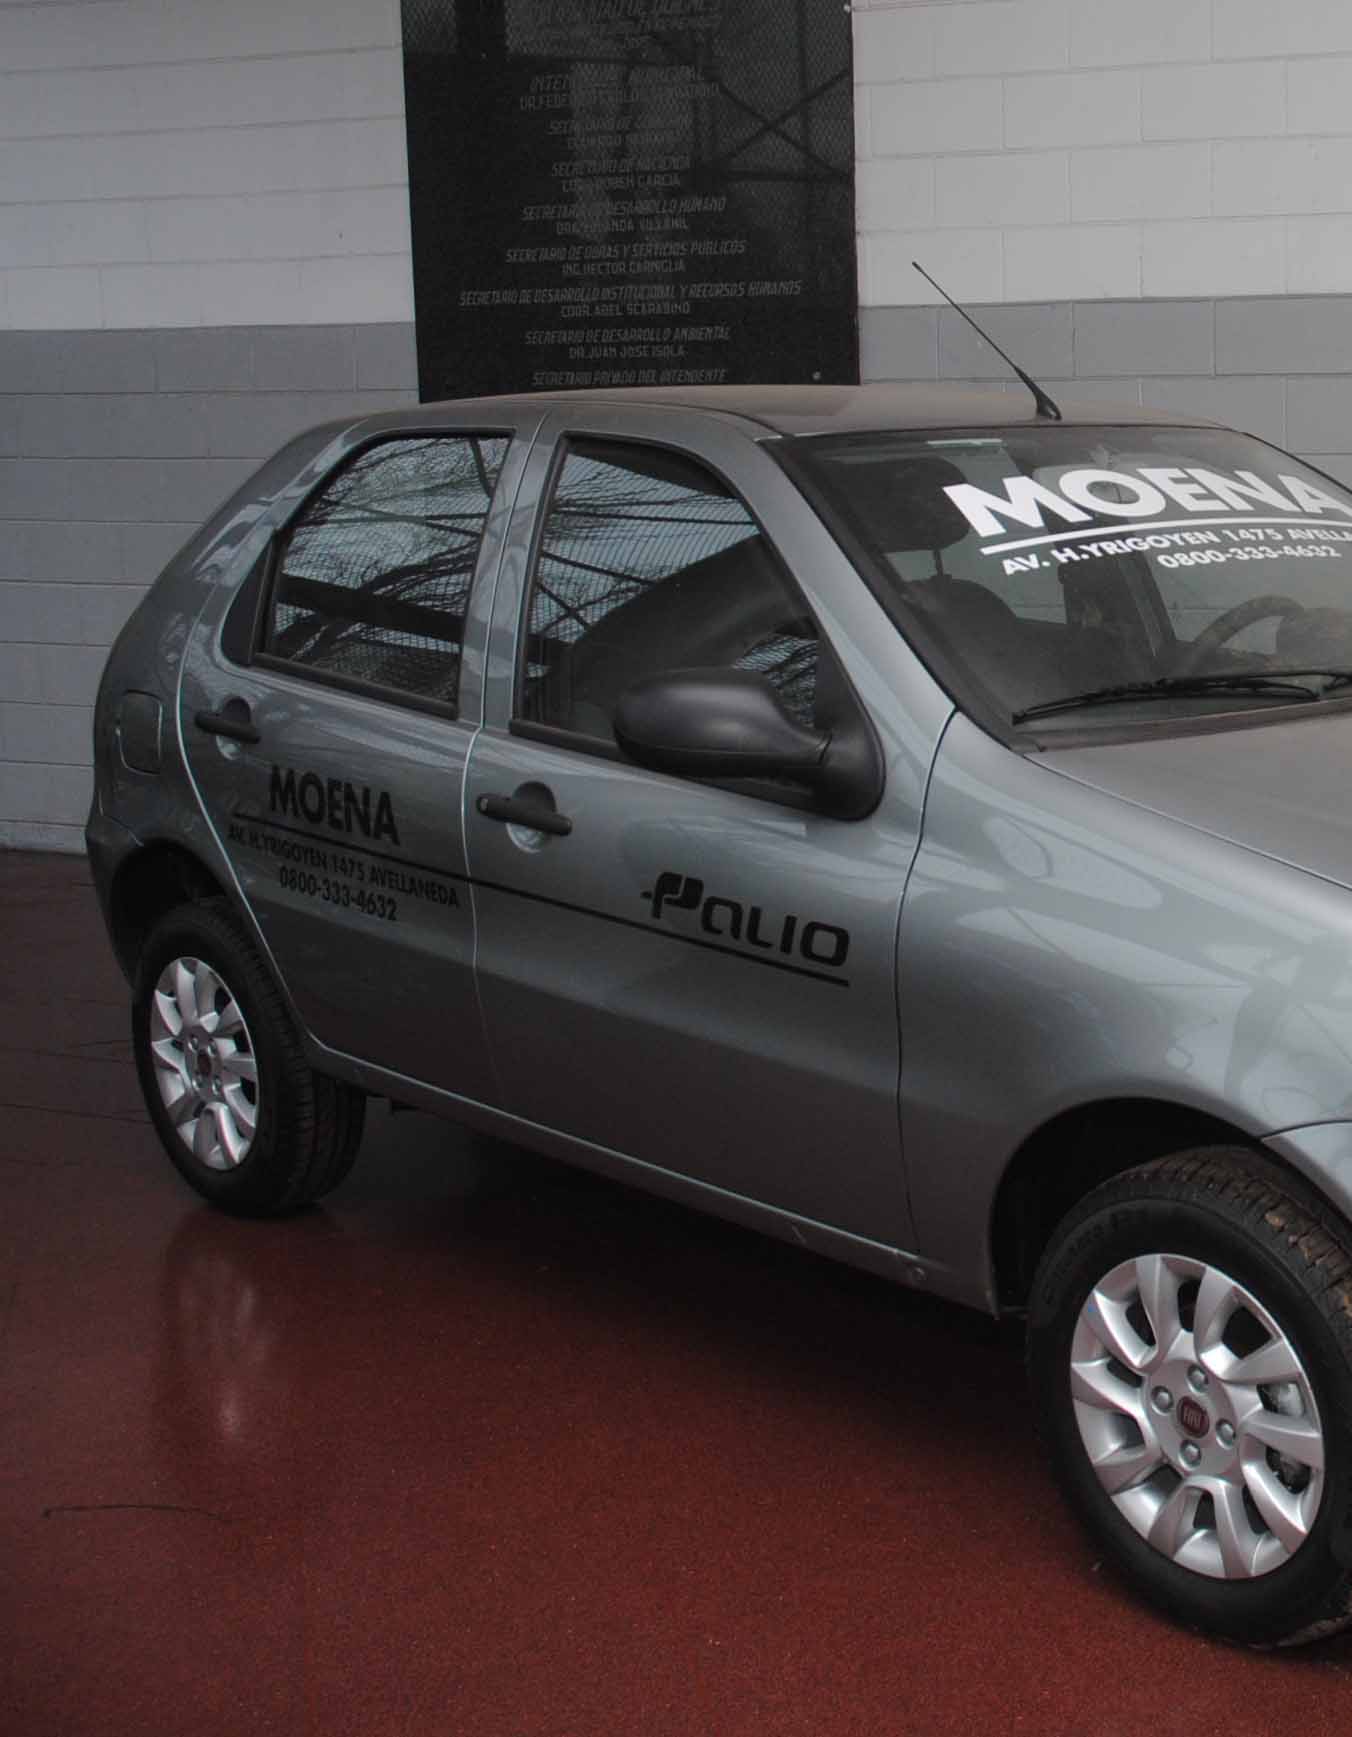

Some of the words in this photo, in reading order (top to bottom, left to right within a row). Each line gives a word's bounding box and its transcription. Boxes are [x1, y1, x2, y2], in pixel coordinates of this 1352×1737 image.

[1002, 553, 1050, 576] AV.
[1221, 528, 1284, 542] 1475
[1157, 545, 1342, 569] 0800-333-4632
[269, 764, 400, 846] MOENA
[279, 864, 399, 921] 0800-333-4632
[331, 854, 365, 882] 1475
[370, 864, 461, 908] AVELLANEDA
